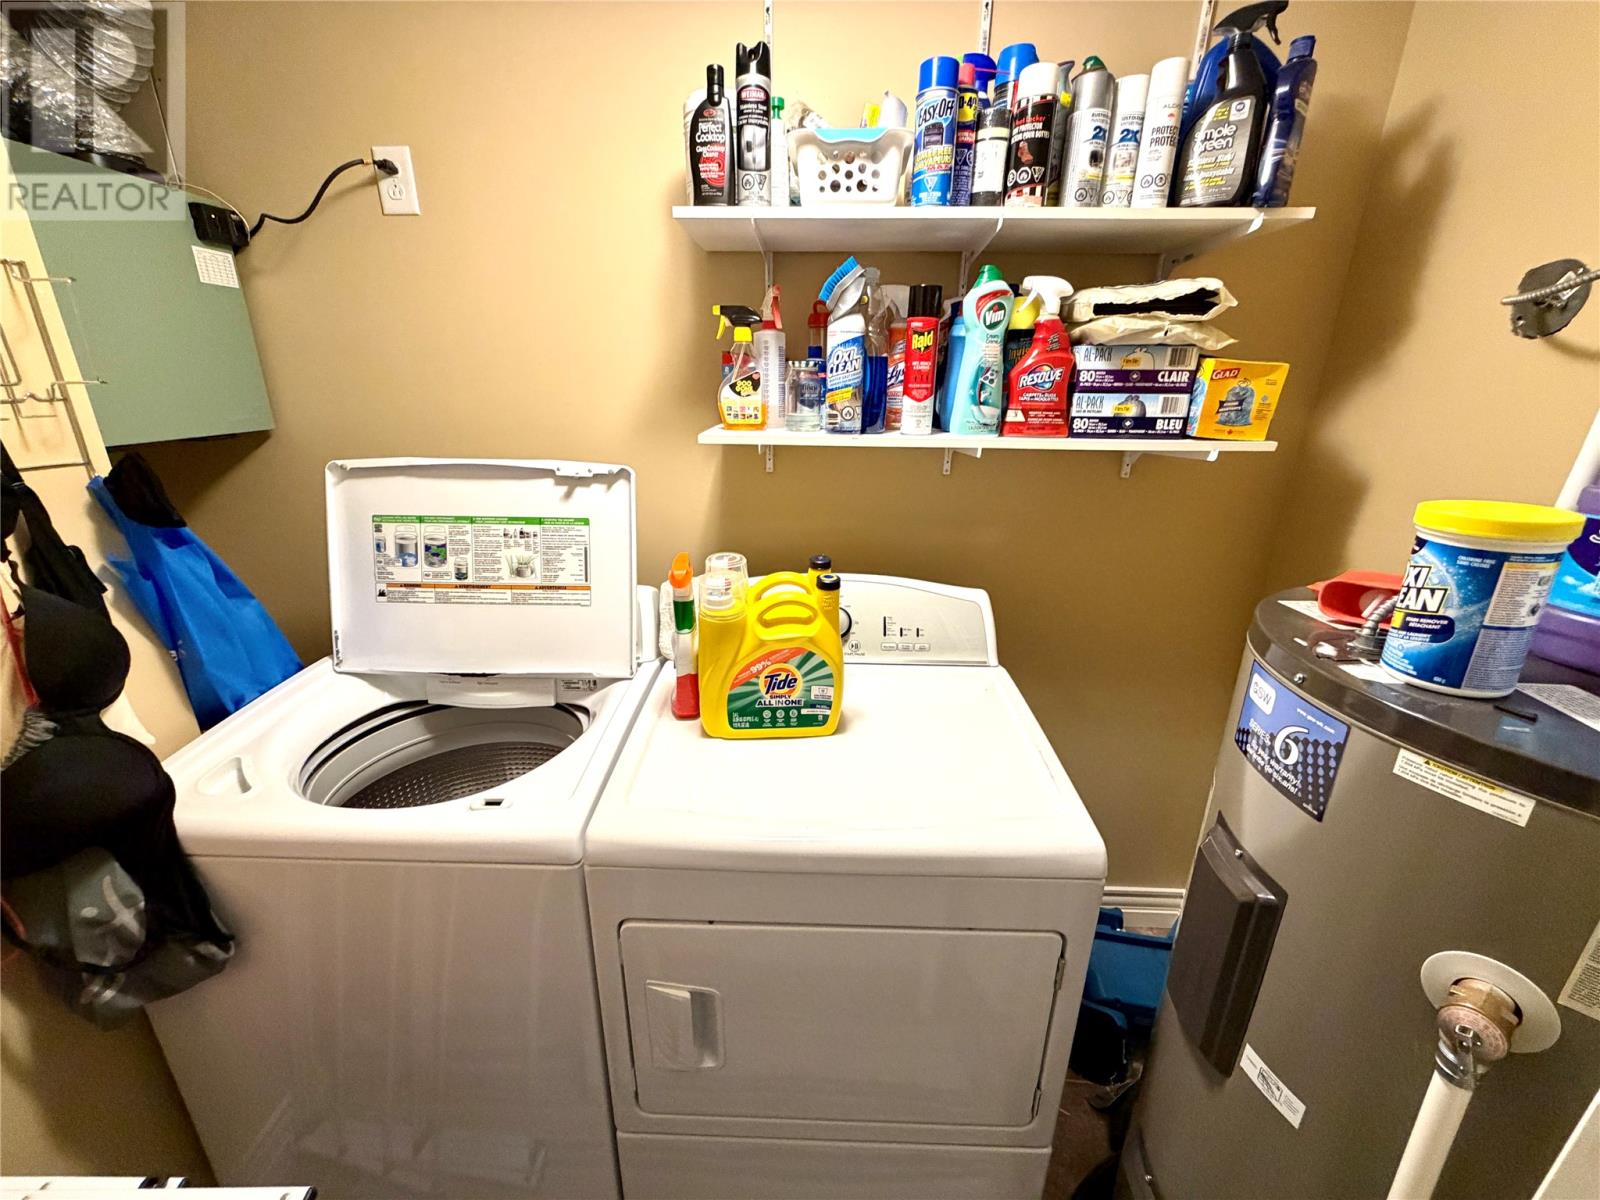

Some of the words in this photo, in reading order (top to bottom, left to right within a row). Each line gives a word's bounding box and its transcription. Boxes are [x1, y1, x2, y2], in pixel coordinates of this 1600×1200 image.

[698, 122, 722, 133] Perfect
[696, 132, 725, 143] Cooktop
[1119, 128, 1140, 144] 2X
[985, 310, 1005, 326] Vim
[911, 330, 934, 352] Raid
[833, 348, 854, 365] OXI
[1084, 347, 1112, 361] AL-PACK
[829, 359, 861, 375] CLEAN
[1212, 369, 1239, 380] GLAD
[1020, 368, 1063, 388] RESOLVE
[1079, 370, 1095, 382] 80
[1158, 371, 1190, 382] CLAIR
[1076, 395, 1105, 409] AL-PACK
[1073, 418, 1089, 430] 80
[1155, 418, 1184, 430] BLEU
[1403, 566, 1430, 588] XI
[1397, 588, 1446, 613] EAN
[750, 659, 771, 673] 99%
[764, 673, 798, 695] Tide
[1253, 681, 1272, 705] GSW
[1249, 718, 1271, 746] SERIES
[1274, 725, 1309, 765] 6
